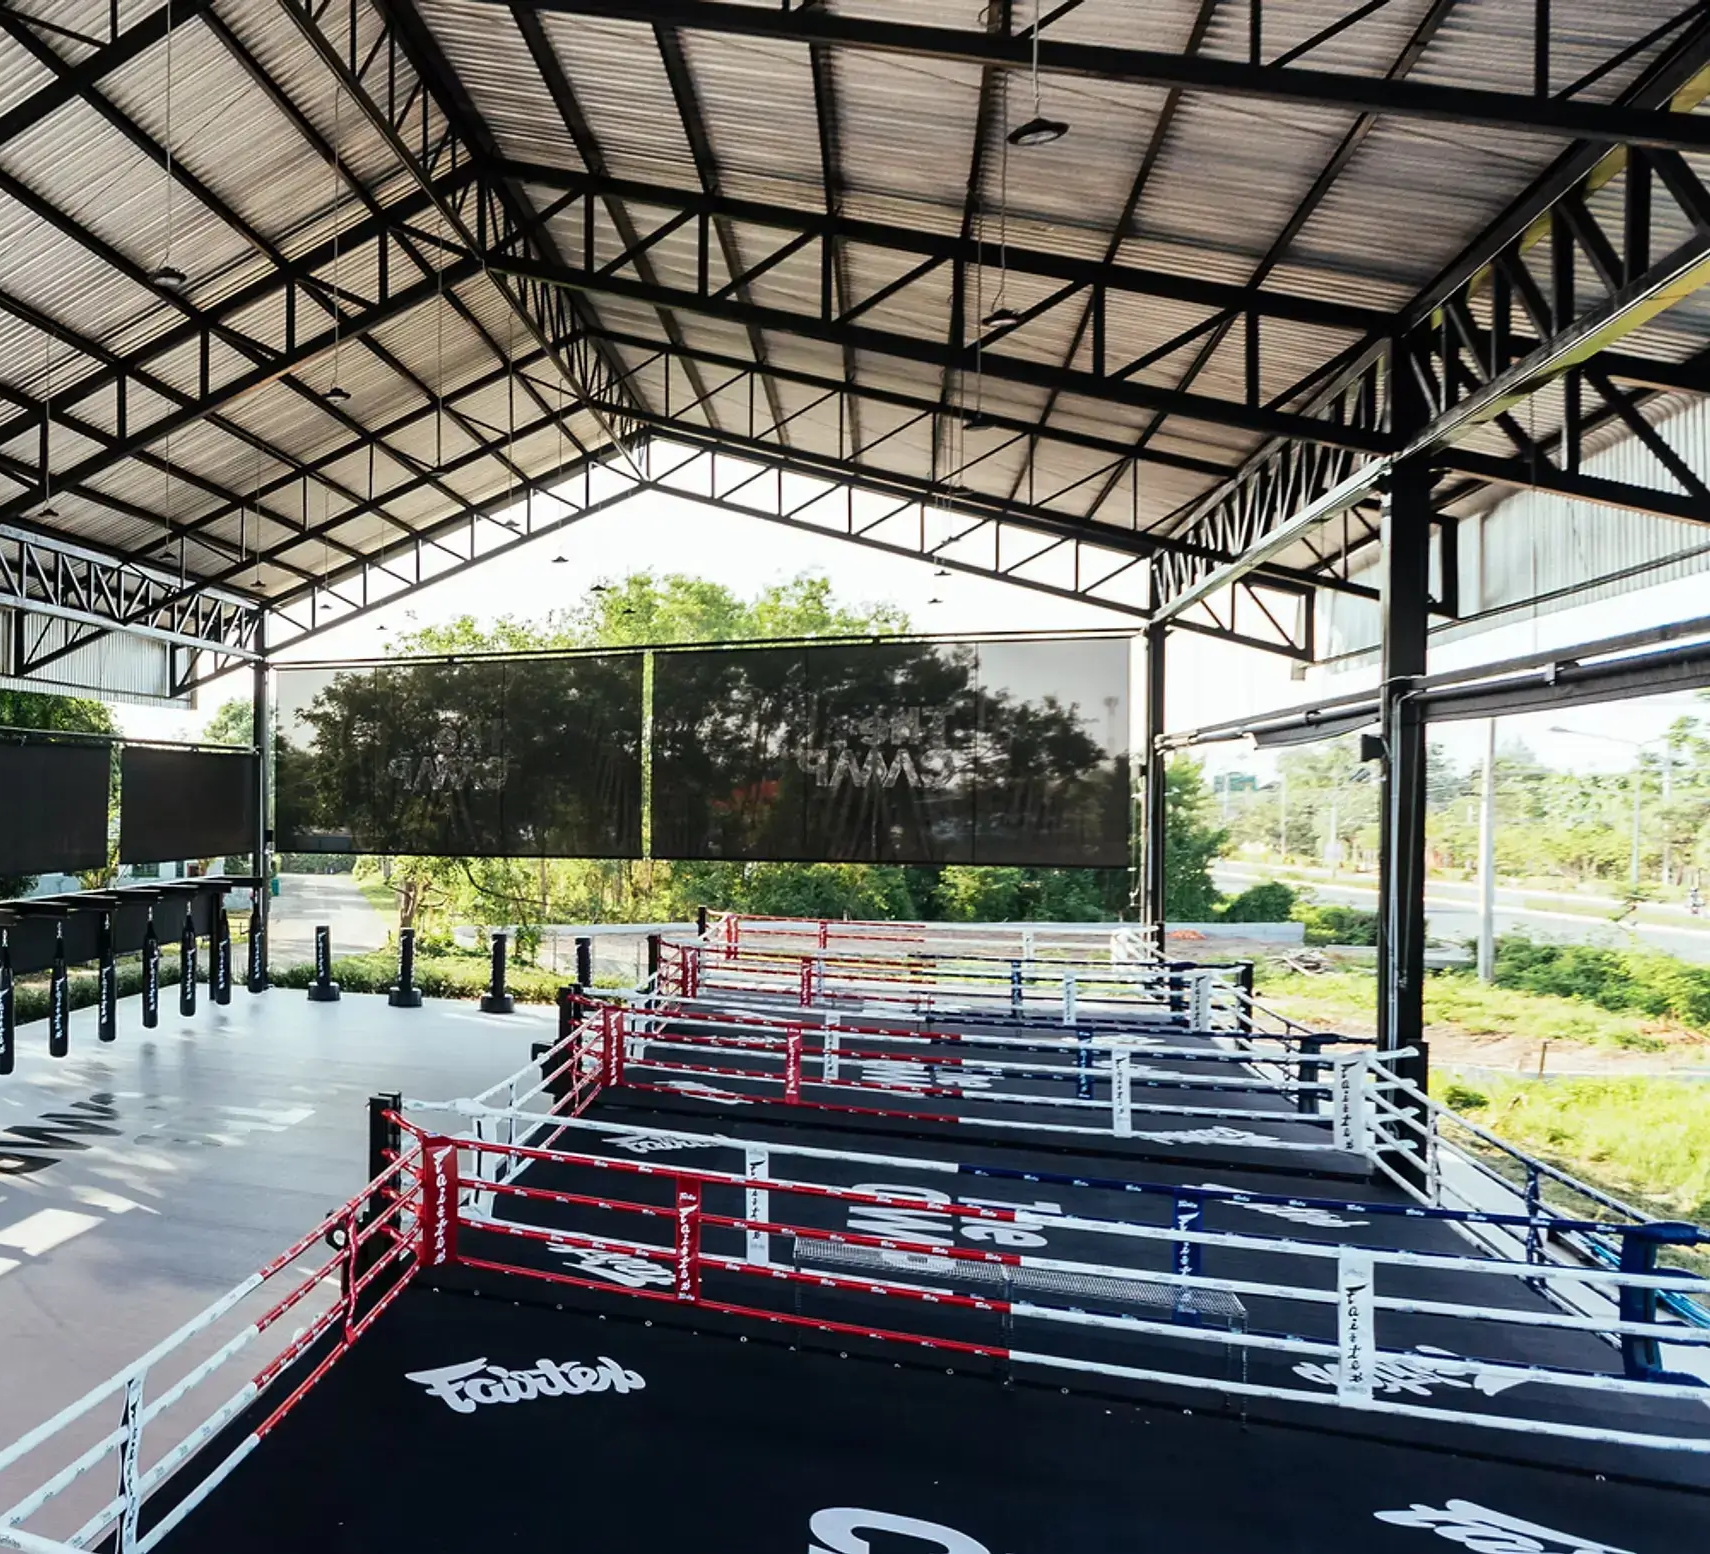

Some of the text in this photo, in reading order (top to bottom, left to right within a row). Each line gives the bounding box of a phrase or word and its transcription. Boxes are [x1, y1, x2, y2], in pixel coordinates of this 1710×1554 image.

[432, 1144, 453, 1266] Fairtex
[1344, 1283, 1368, 1383] Fairtex
[404, 1356, 647, 1414] Fairtex
